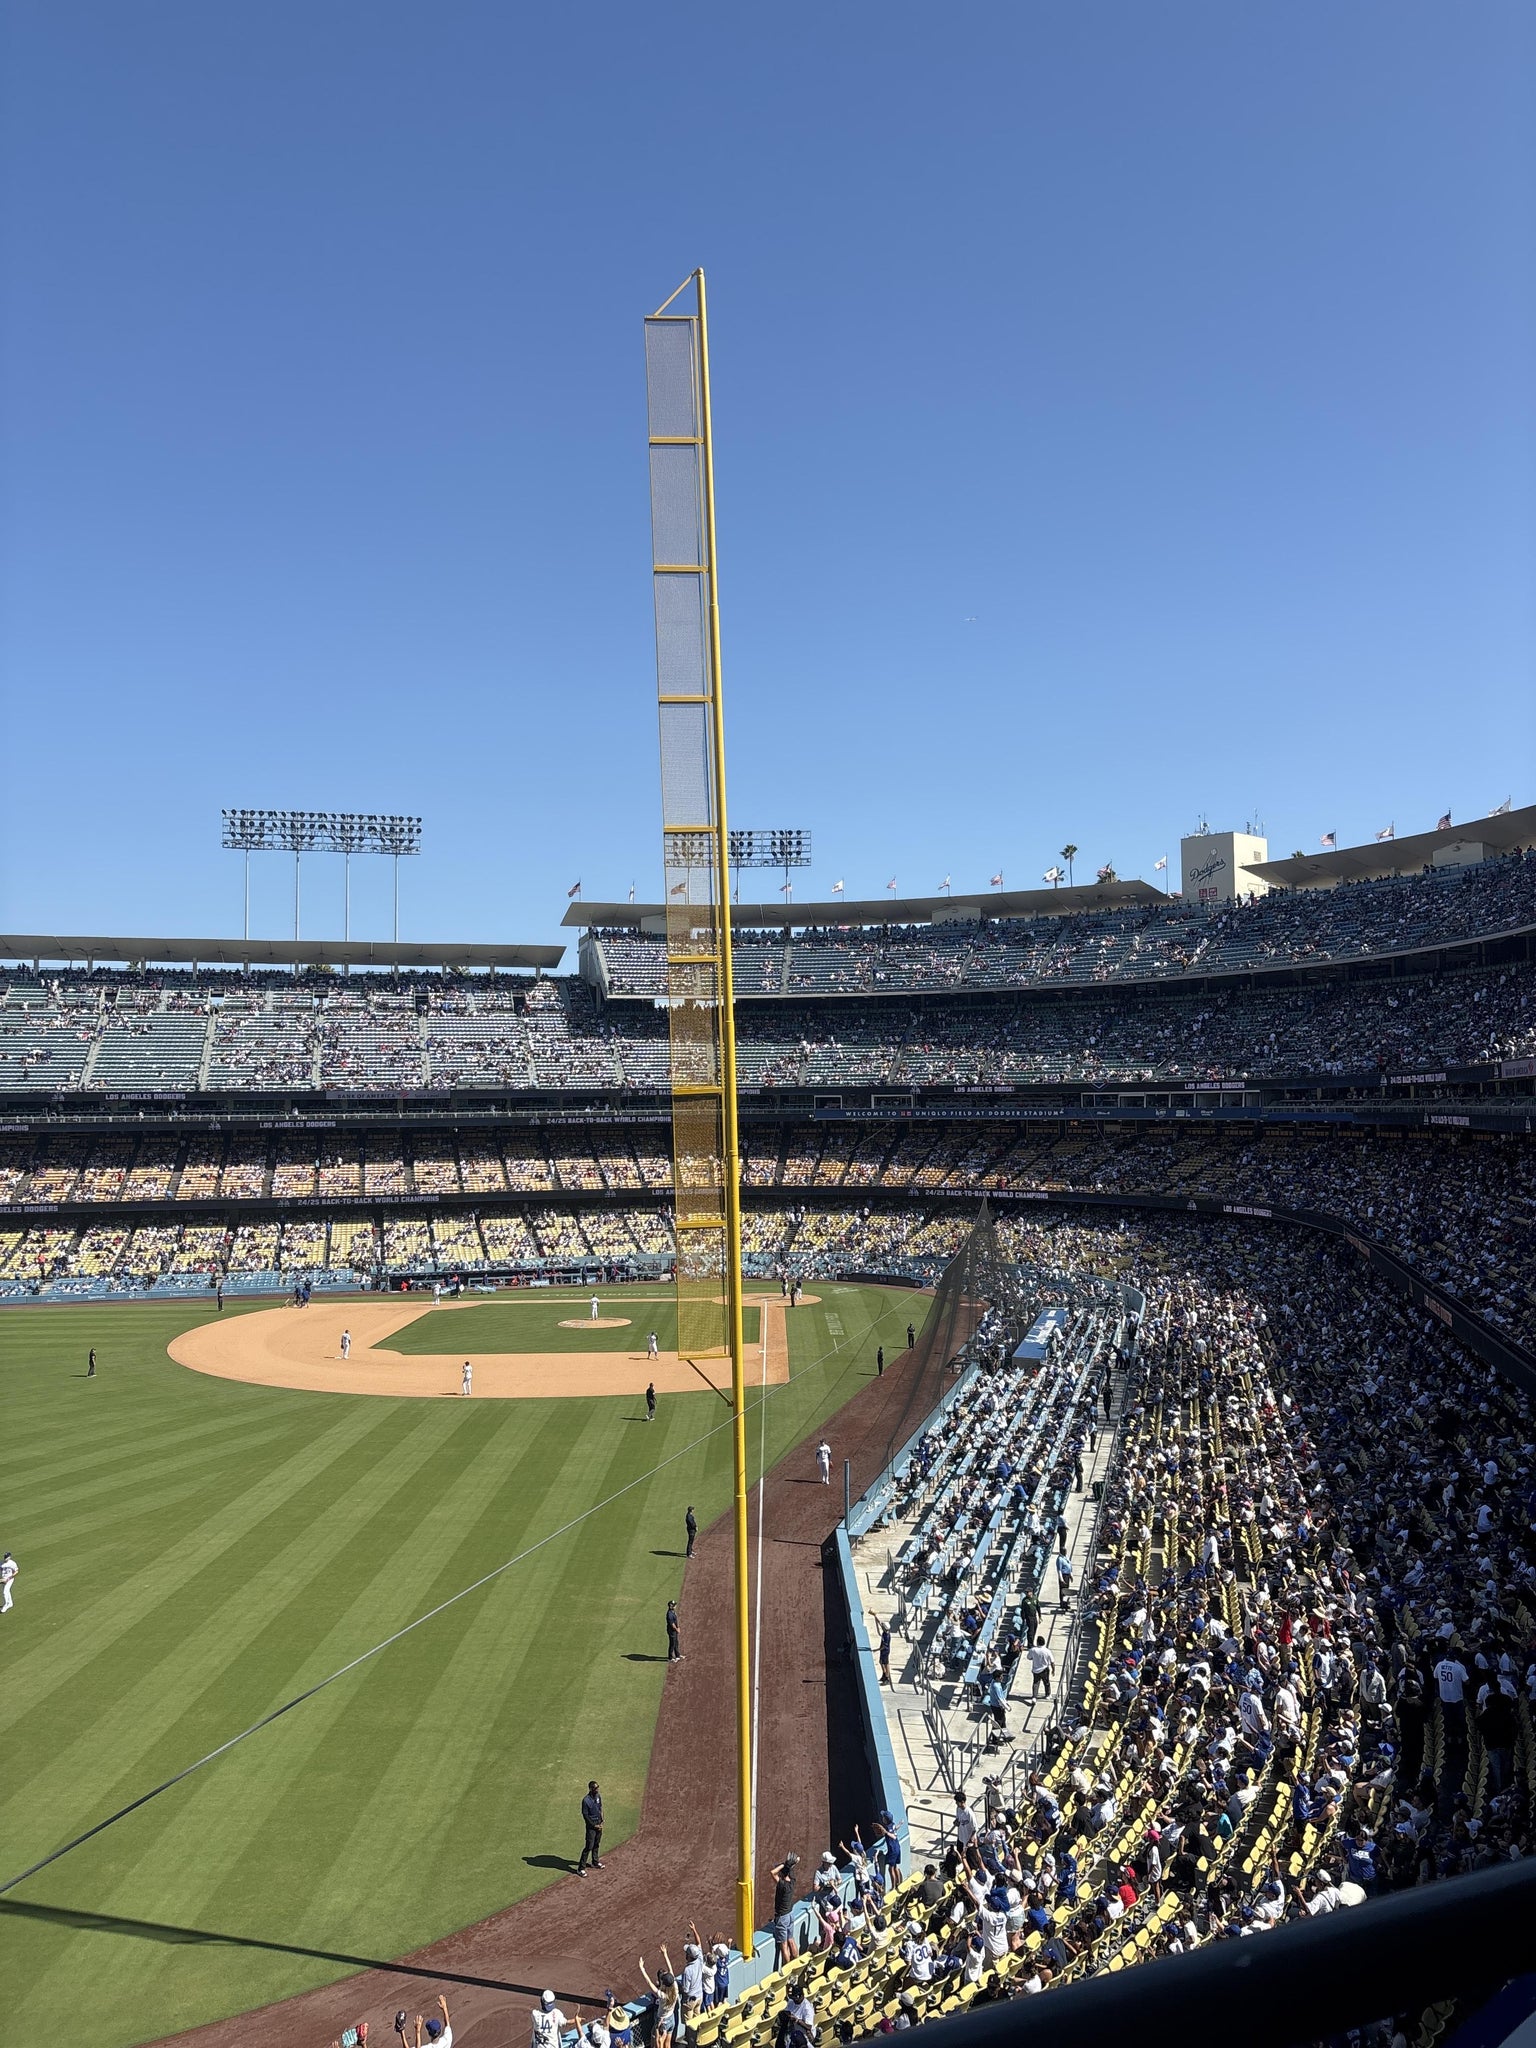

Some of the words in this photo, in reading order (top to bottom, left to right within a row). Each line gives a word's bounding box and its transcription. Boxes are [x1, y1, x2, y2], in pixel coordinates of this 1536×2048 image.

[1190, 858, 1226, 881] Dodgers
[1441, 1671, 1453, 1682] 50
[1243, 1702, 1251, 1714] 50
[993, 1924, 1003, 1936] 17
[916, 1946, 928, 1961] 30
[541, 2015, 552, 2033] LA
